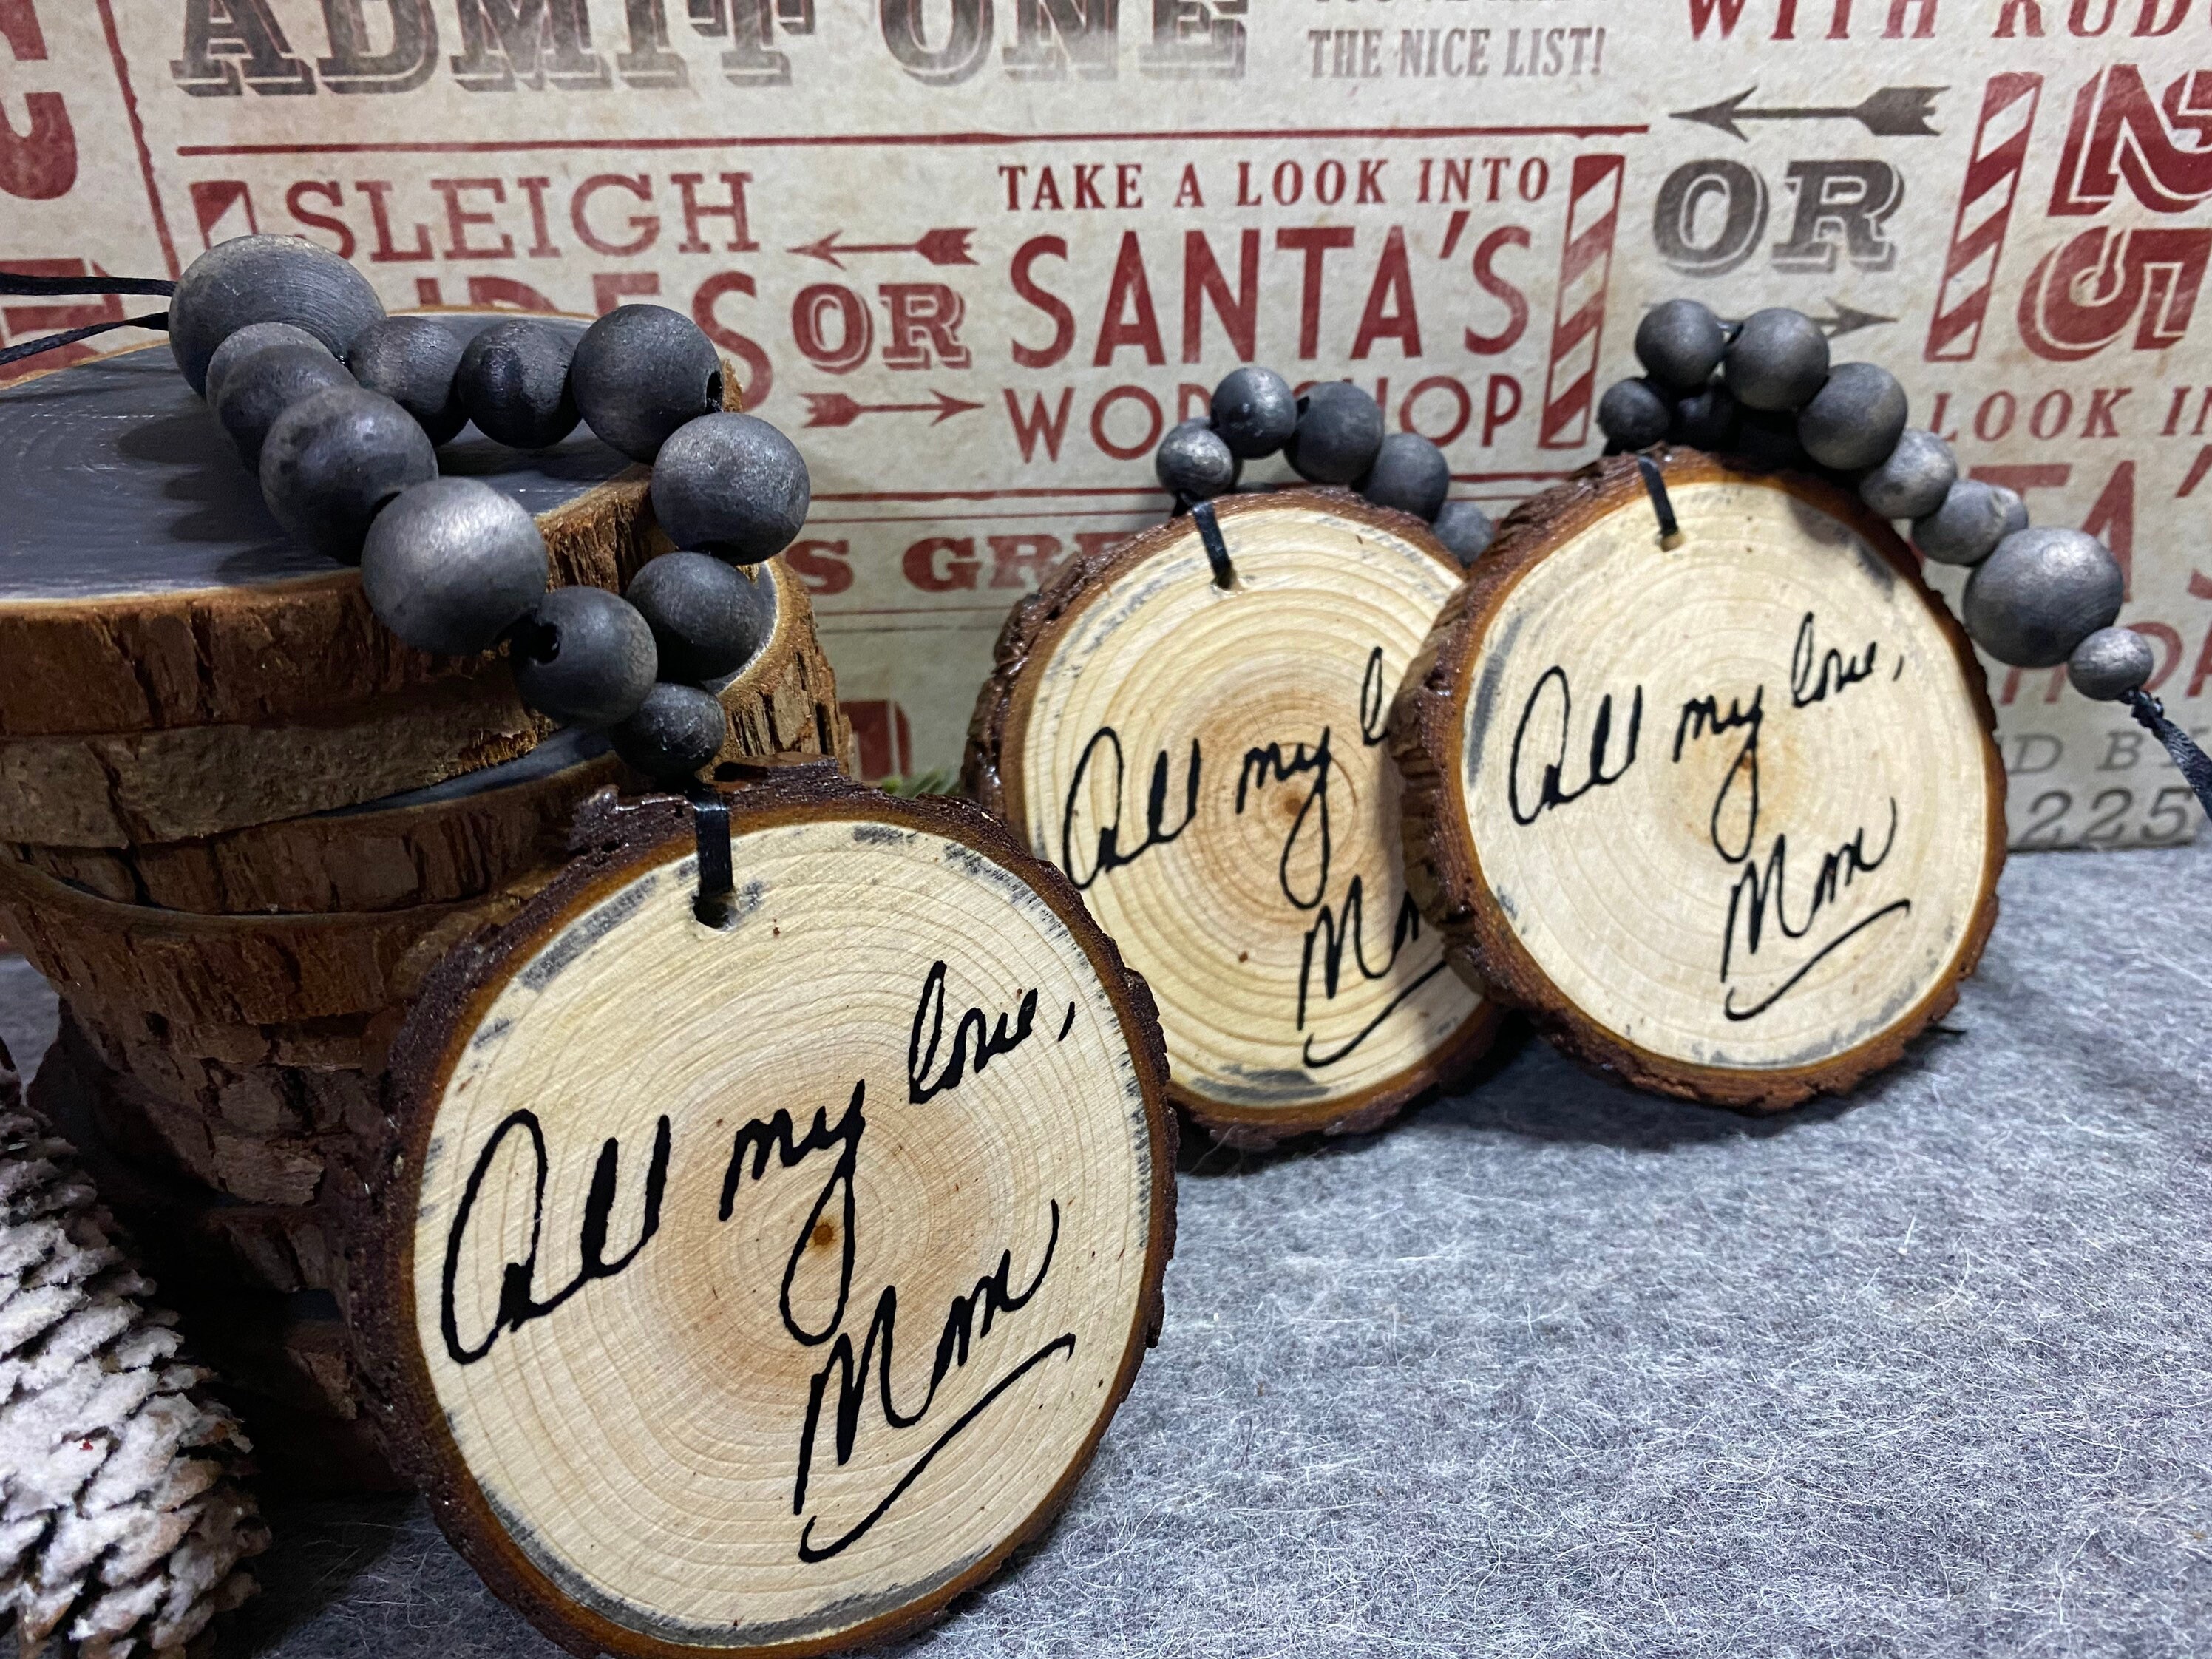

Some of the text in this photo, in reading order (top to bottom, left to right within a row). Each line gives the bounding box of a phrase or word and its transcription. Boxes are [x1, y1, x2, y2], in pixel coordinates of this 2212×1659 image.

[1308, 27, 1607, 78] THE NICE LIST!
[285, 172, 760, 262] SLEIGH
[998, 157, 1550, 212] TAKE A LOOK INTO
[1652, 158, 1906, 277] OR
[790, 282, 973, 371] OR
[1010, 210, 1532, 369] SANTA'S
[1929, 386, 2133, 442] LOOK
[1062, 727, 1201, 889] All
[1236, 726, 1332, 910] my
[1509, 665, 1641, 825] All
[1673, 685, 1763, 863] my
[1720, 797, 1898, 983] Mom
[441, 1109, 671, 1365] All
[719, 1079, 866, 1346] my
[793, 1198, 1060, 1515] Mom
